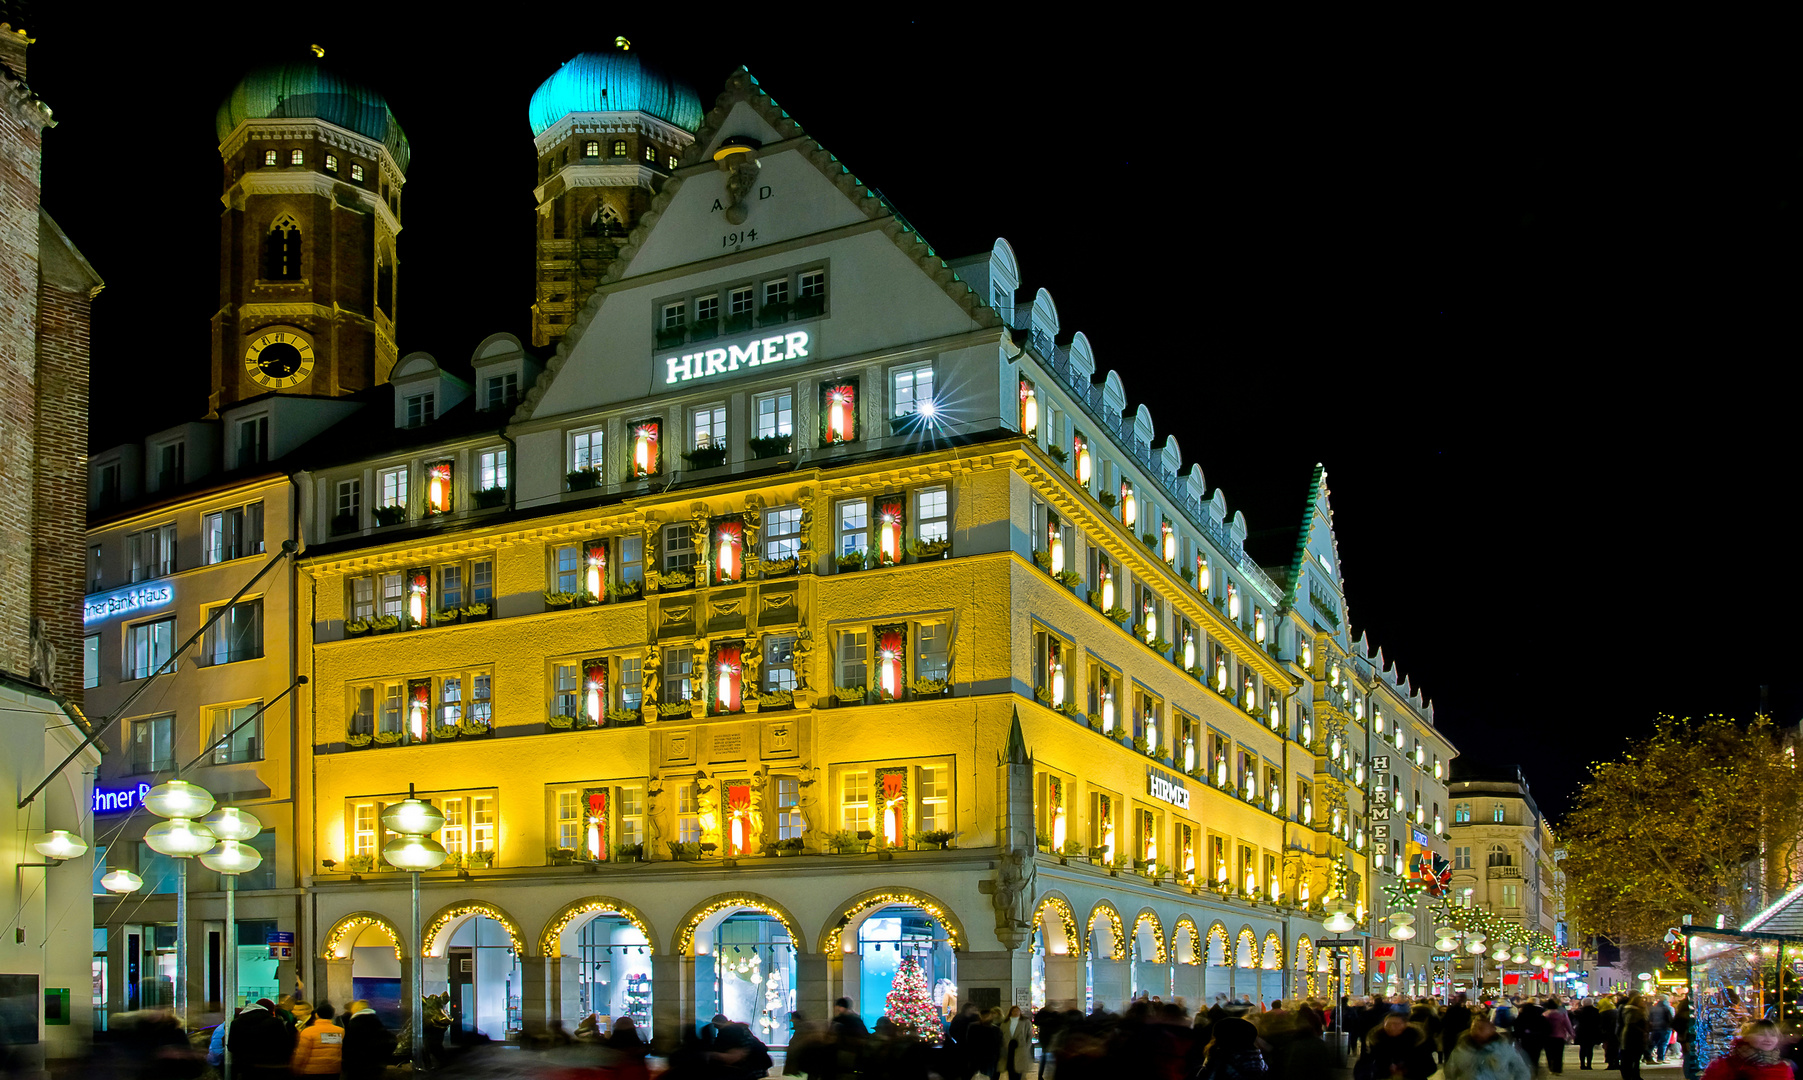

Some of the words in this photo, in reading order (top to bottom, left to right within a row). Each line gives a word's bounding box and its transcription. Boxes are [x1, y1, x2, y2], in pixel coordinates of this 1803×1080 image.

[666, 331, 809, 384] HIRMER
[108, 592, 135, 612] Bank
[138, 588, 167, 606] Haus
[92, 788, 136, 811] hner
[1150, 774, 1190, 810] HIRMER
[1373, 757, 1389, 854] HIRMER
